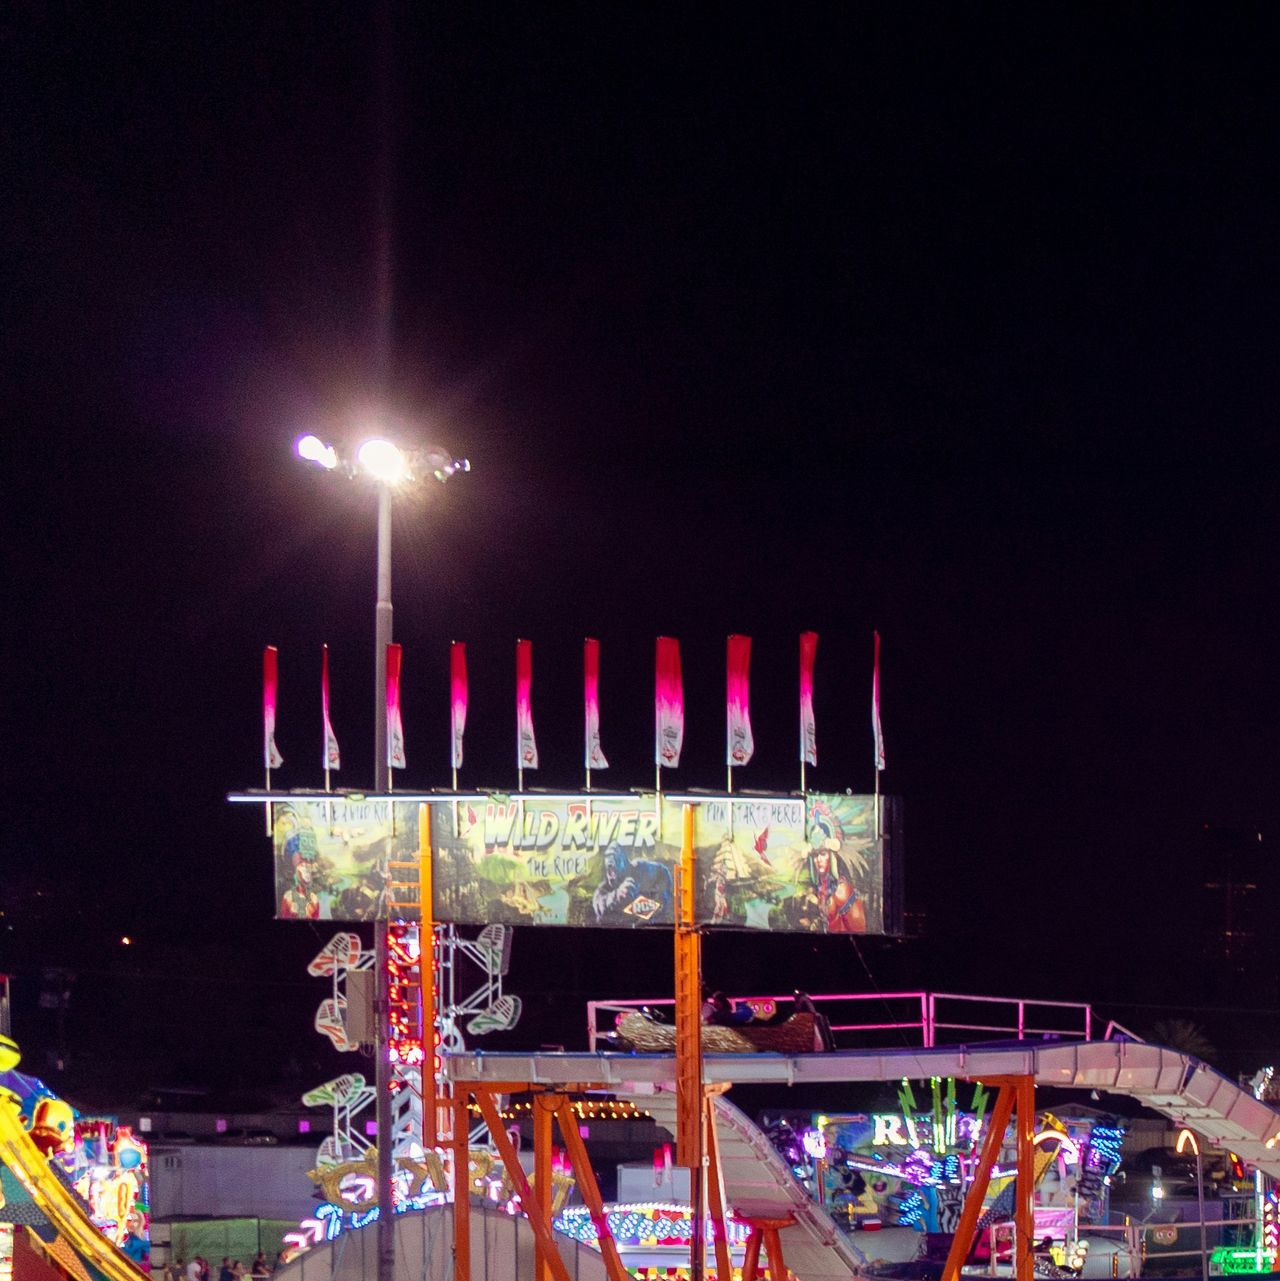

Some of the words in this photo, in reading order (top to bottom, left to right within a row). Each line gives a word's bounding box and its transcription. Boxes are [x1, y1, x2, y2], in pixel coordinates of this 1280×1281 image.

[771, 803, 802, 824] HERE!
[484, 803, 560, 850] WILD
[563, 803, 658, 852] RIVER
[528, 857, 551, 877] THE
[554, 855, 587, 879] RIDE!
